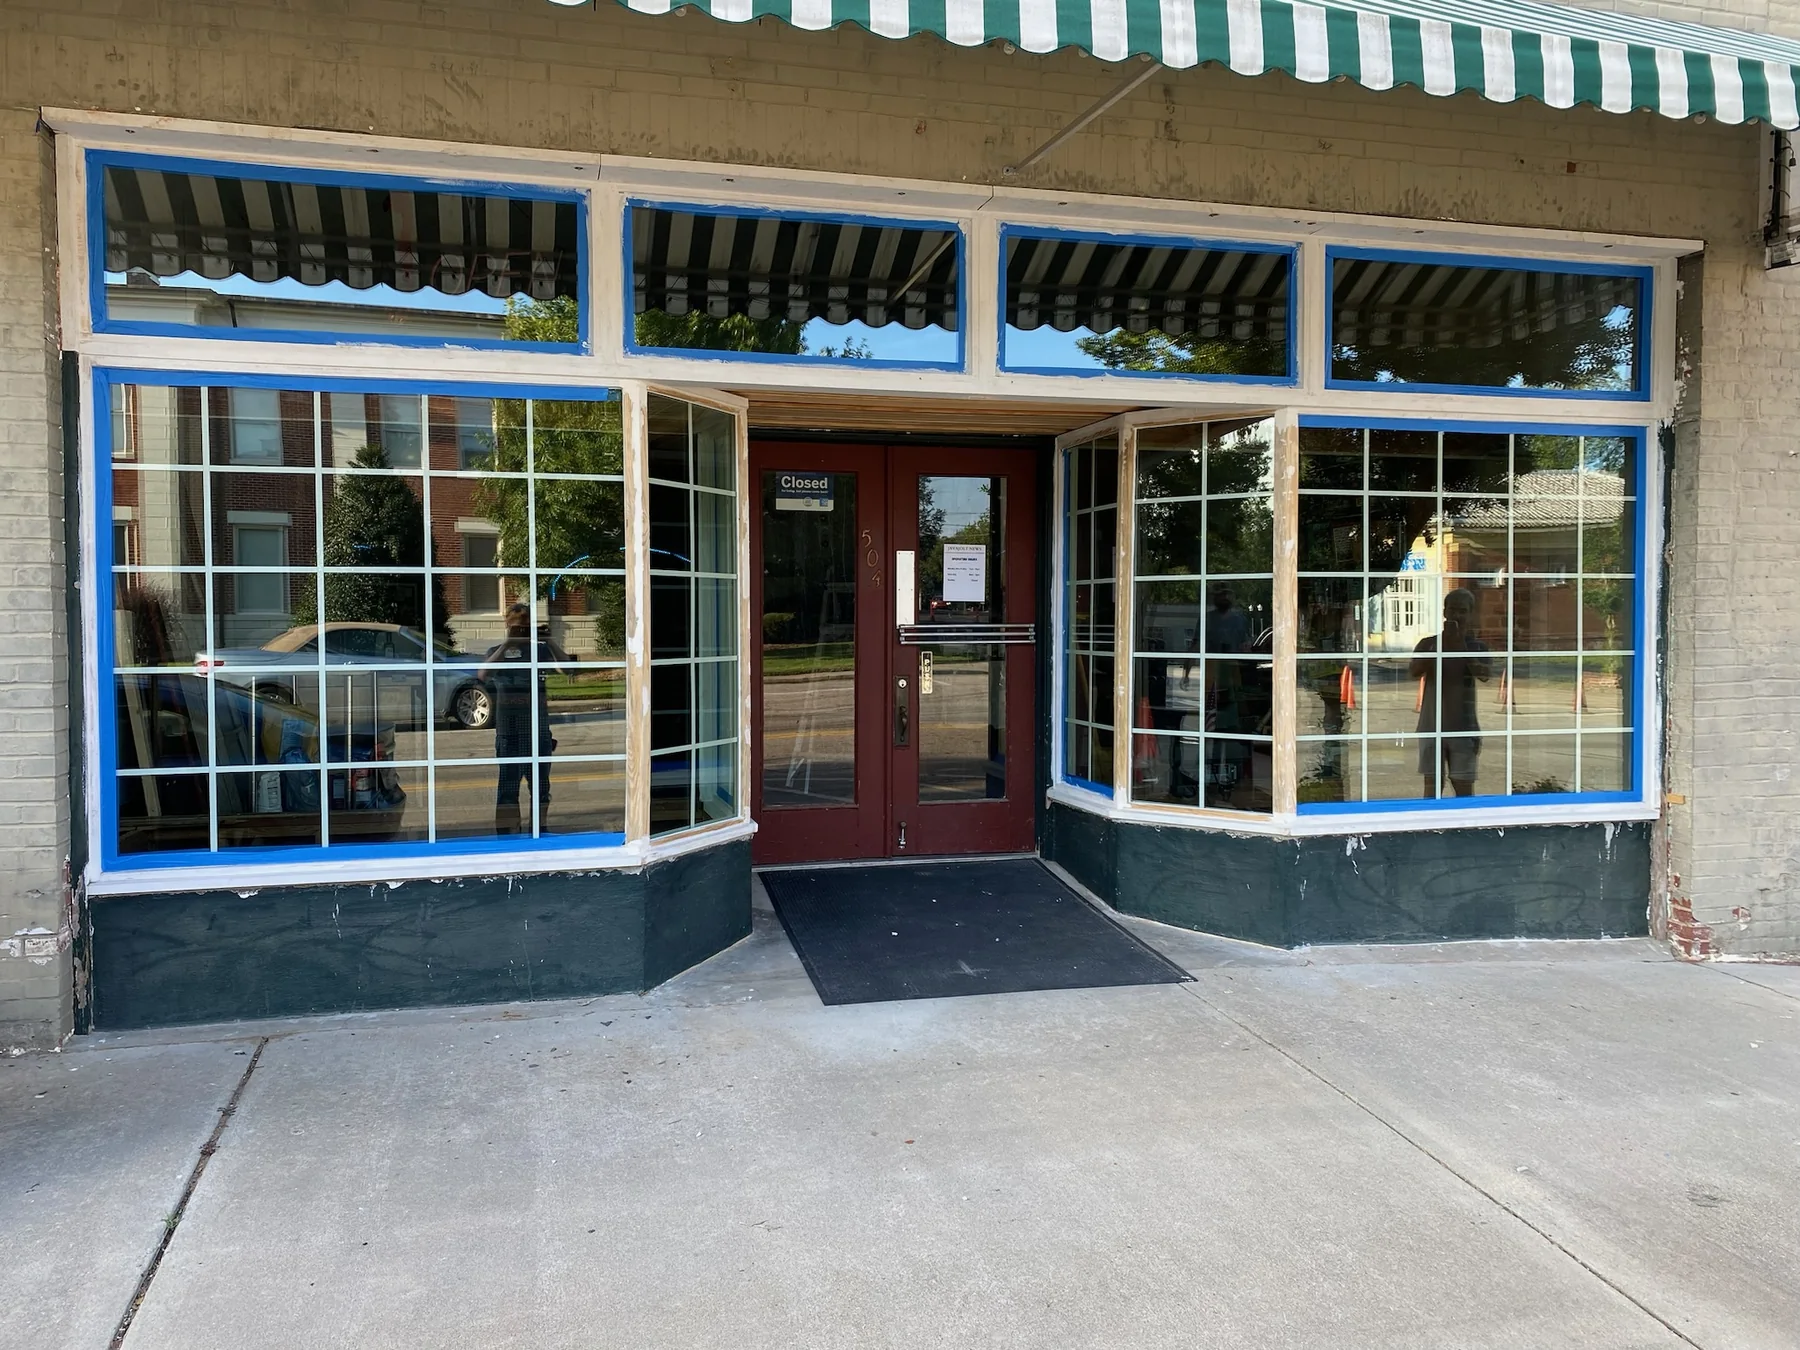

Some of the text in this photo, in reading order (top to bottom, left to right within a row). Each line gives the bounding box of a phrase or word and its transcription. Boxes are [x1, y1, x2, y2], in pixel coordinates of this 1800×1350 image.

[429, 250, 563, 295] OPEN
[781, 475, 828, 489] Closed
[862, 529, 881, 588] 504
